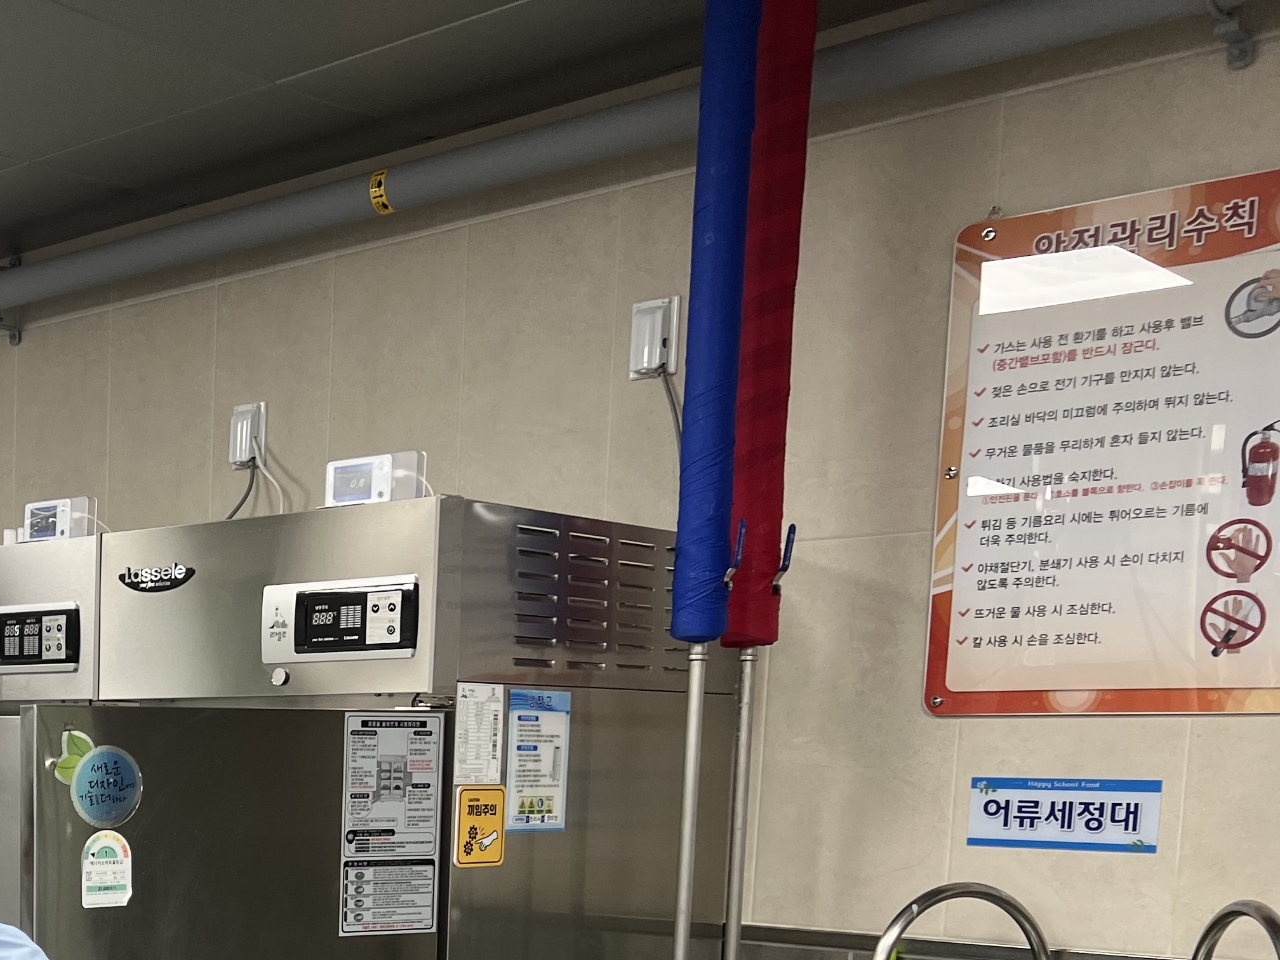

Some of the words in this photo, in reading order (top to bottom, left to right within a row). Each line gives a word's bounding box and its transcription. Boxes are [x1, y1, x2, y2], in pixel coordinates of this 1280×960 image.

[993, 340, 1027, 354] 가스는
[1030, 335, 1053, 349] 사용
[1058, 333, 1069, 346] 전
[1073, 328, 1108, 344] 환기를
[1111, 325, 1135, 338] 하고
[1139, 318, 1176, 334] 사용후
[1180, 315, 1204, 330] 밸브
[992, 349, 1078, 372] (중간밸브포함)를
[1082, 343, 1117, 360] 반드시
[1121, 338, 1160, 354] 잠근다.
[991, 384, 1013, 399] 젖은
[1017, 380, 1050, 396] 손으로
[1054, 376, 1077, 391] 전기
[1081, 372, 1116, 387] 기구를
[1120, 366, 1156, 383] 만지지
[1160, 362, 1200, 378] 않는다.
[987, 414, 1021, 428] 조리실
[1024, 409, 1058, 424] 바닥의
[1062, 403, 1108, 420] 미끄럼에
[1112, 397, 1160, 414] 주의하며
[1164, 394, 1189, 409] 뛰지
[1193, 390, 1233, 406] 않는다.
[985, 445, 1018, 460] 무거운
[1022, 441, 1055, 457] 물품을
[1059, 436, 1106, 453] 무리하게
[1110, 433, 1133, 448] 혼자
[1137, 430, 1162, 445] 들지
[1166, 426, 1206, 442] 않는다.
[1020, 472, 1064, 488] 사용법을
[1068, 467, 1118, 482] 숙지한다.
[981, 518, 1002, 531] 튀김
[1006, 517, 1017, 530] 등
[1021, 513, 1065, 528] 기름요리
[1070, 511, 1104, 524] 시에는
[1108, 506, 1167, 521] 튀어오르는
[1172, 502, 1209, 517] 기름에
[979, 534, 1001, 547] 더욱
[1005, 531, 1052, 546] 주의한다.
[124, 562, 187, 584] Lassele
[977, 560, 1034, 574] 야채절단기,
[1038, 557, 1073, 571] 분쇄기
[1076, 555, 1099, 569] 사용
[1104, 554, 1116, 567] 시
[1120, 553, 1143, 567] 손이
[1148, 550, 1184, 564] 다치지
[976, 577, 1009, 592] 않도록
[1012, 575, 1059, 589] 주의한다.
[974, 607, 1006, 619] 뜨거운
[1010, 606, 1021, 619] 물
[1025, 604, 1047, 617] 사용
[1051, 604, 1063, 616] 시
[1066, 602, 1116, 615] 조심한다.
[972, 636, 983, 649] 칼
[986, 635, 1008, 648] 사용
[1011, 635, 1023, 647] 시
[1026, 633, 1049, 646] 손을
[1052, 632, 1102, 645] 조심한다.
[1027, 780, 1052, 788] Happy
[1053, 780, 1079, 788] School
[467, 803, 497, 817] 끼임주의
[982, 798, 1141, 833] 어류세정대
